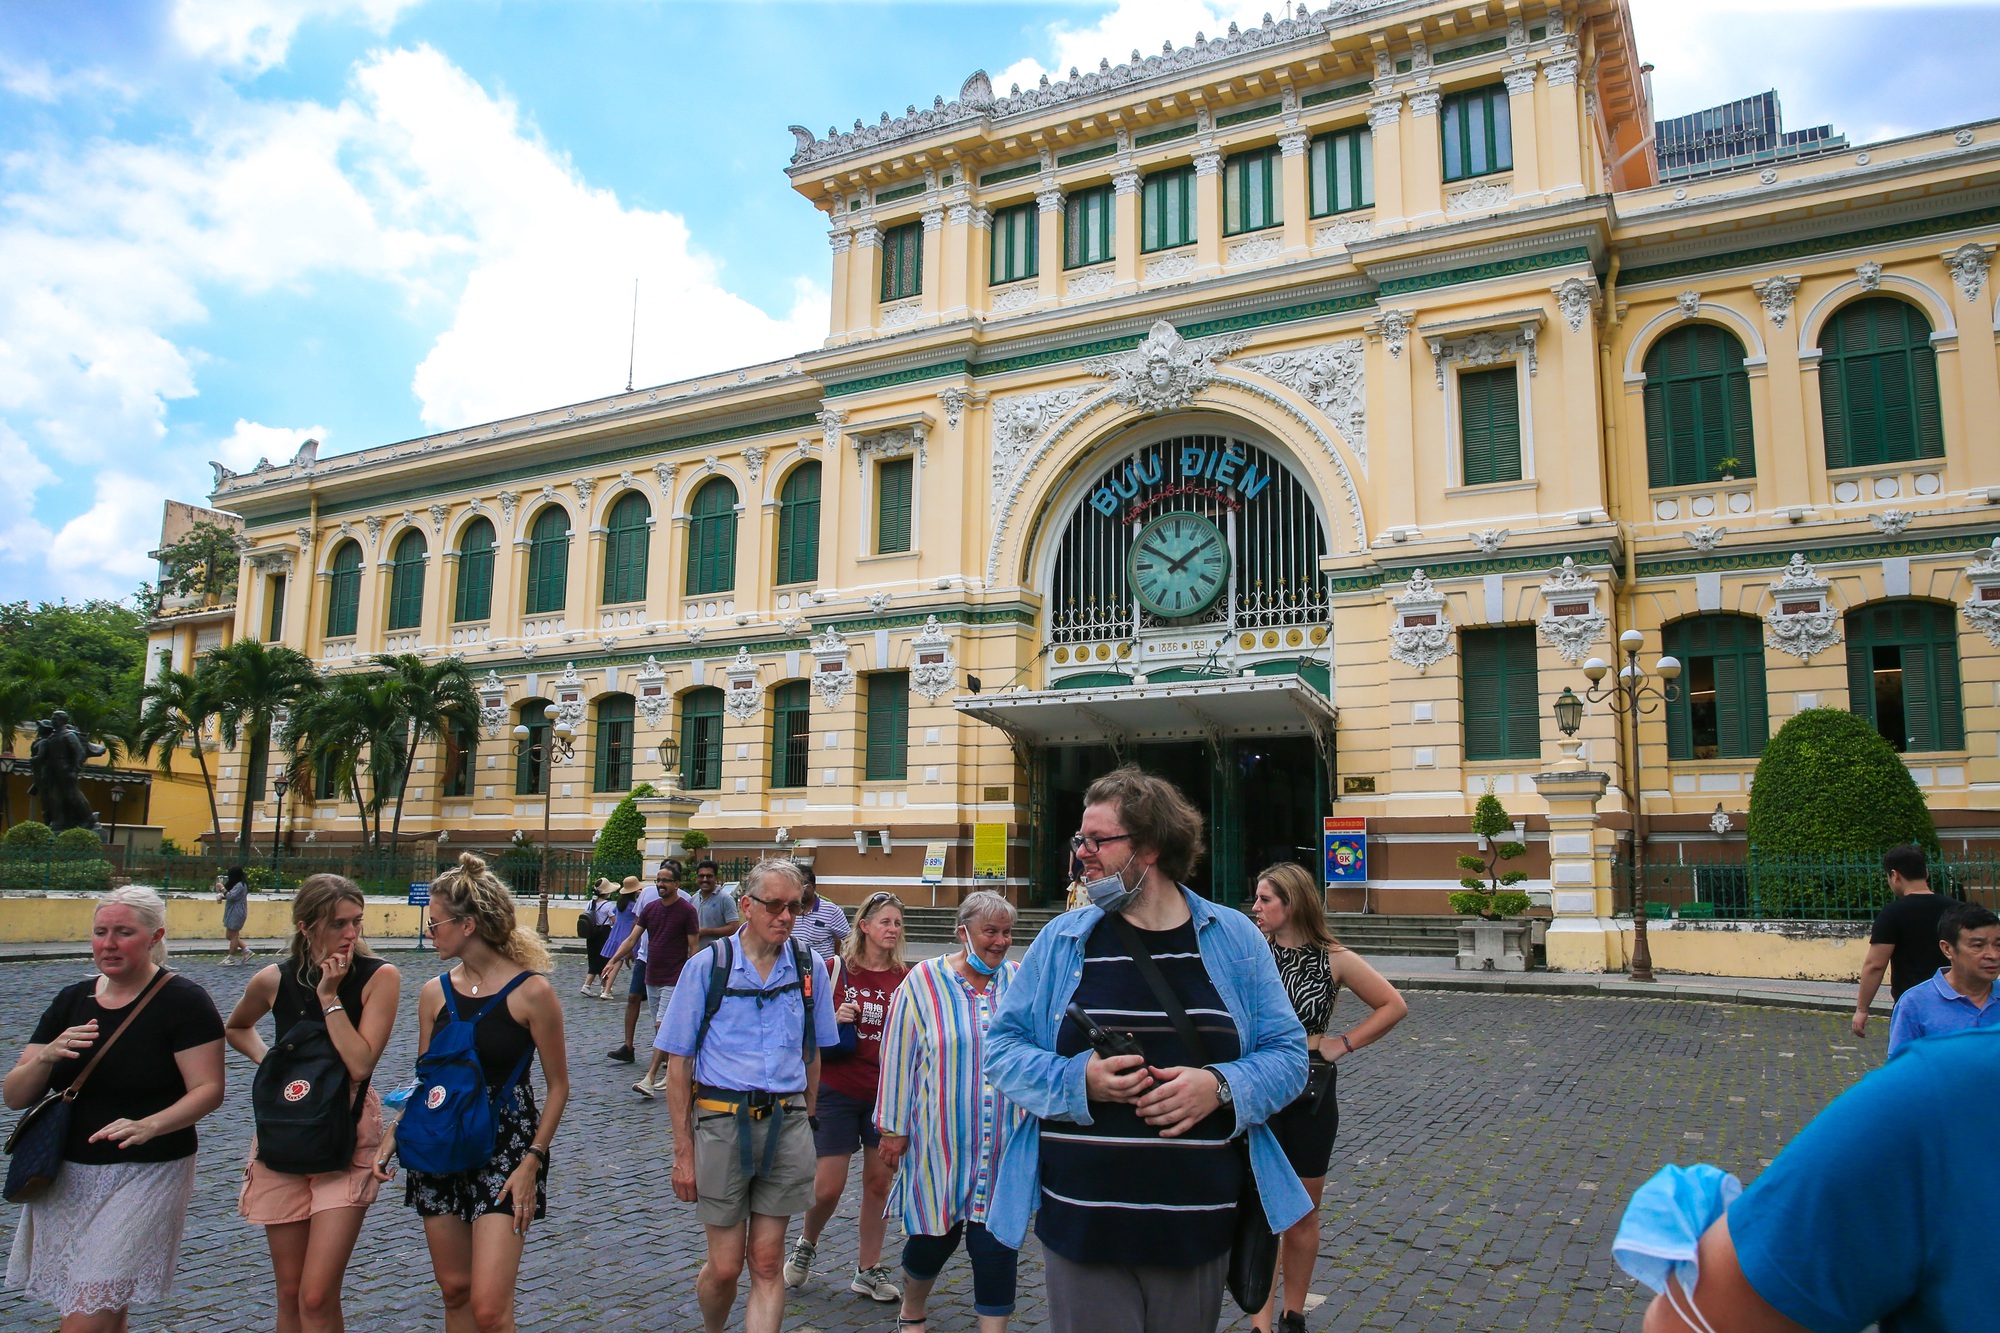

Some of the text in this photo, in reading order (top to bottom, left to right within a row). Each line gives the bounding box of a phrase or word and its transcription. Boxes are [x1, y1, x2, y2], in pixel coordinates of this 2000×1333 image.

[1089, 446, 1272, 517] BƯU ĐIỆN
[1158, 642, 1178, 653] 1886
